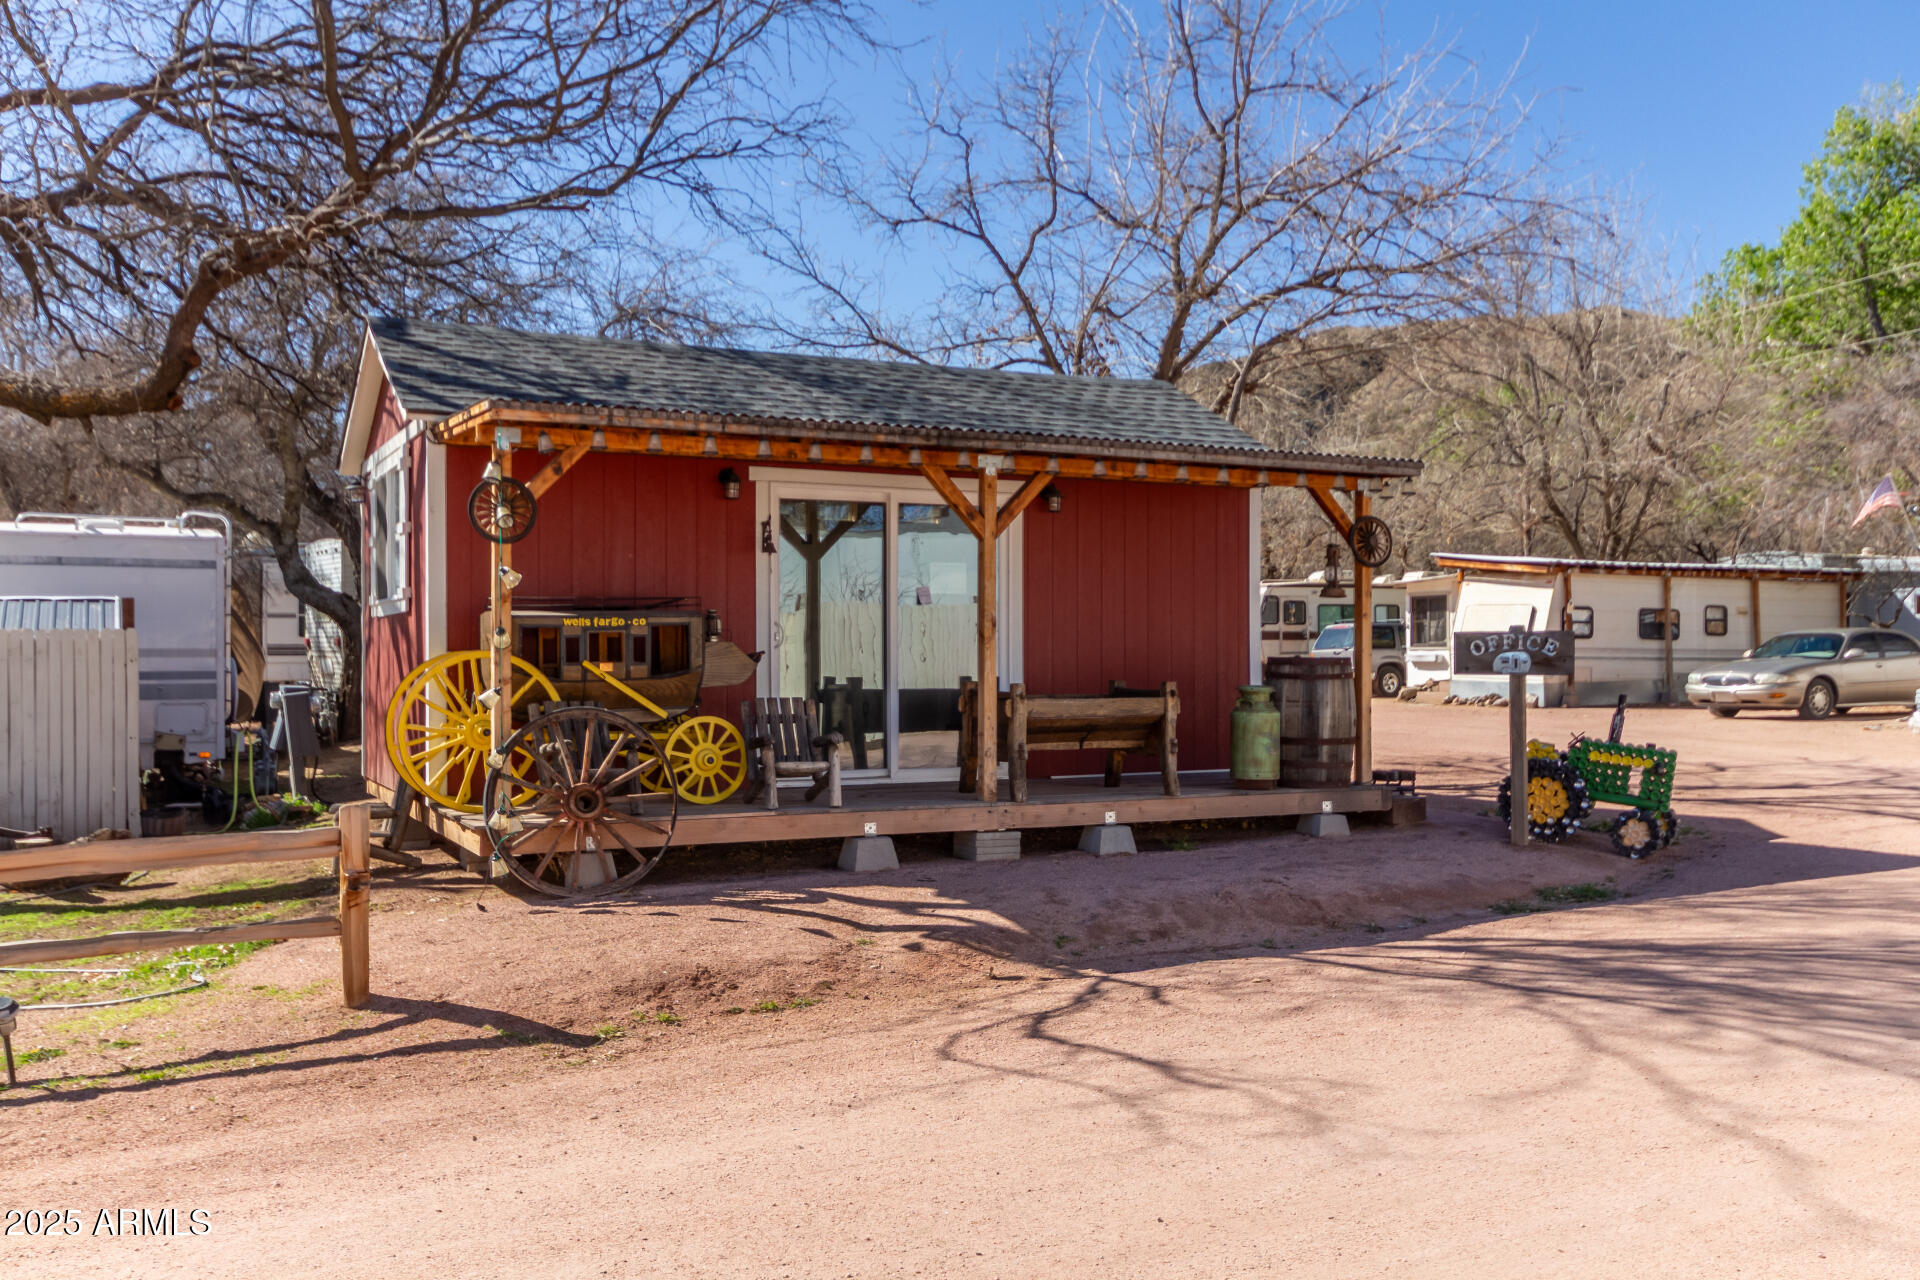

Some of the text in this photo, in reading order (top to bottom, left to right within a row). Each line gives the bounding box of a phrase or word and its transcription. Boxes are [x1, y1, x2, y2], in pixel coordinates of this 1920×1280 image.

[563, 617, 647, 628] wells fargo co
[1470, 633, 1560, 656] OFFICE
